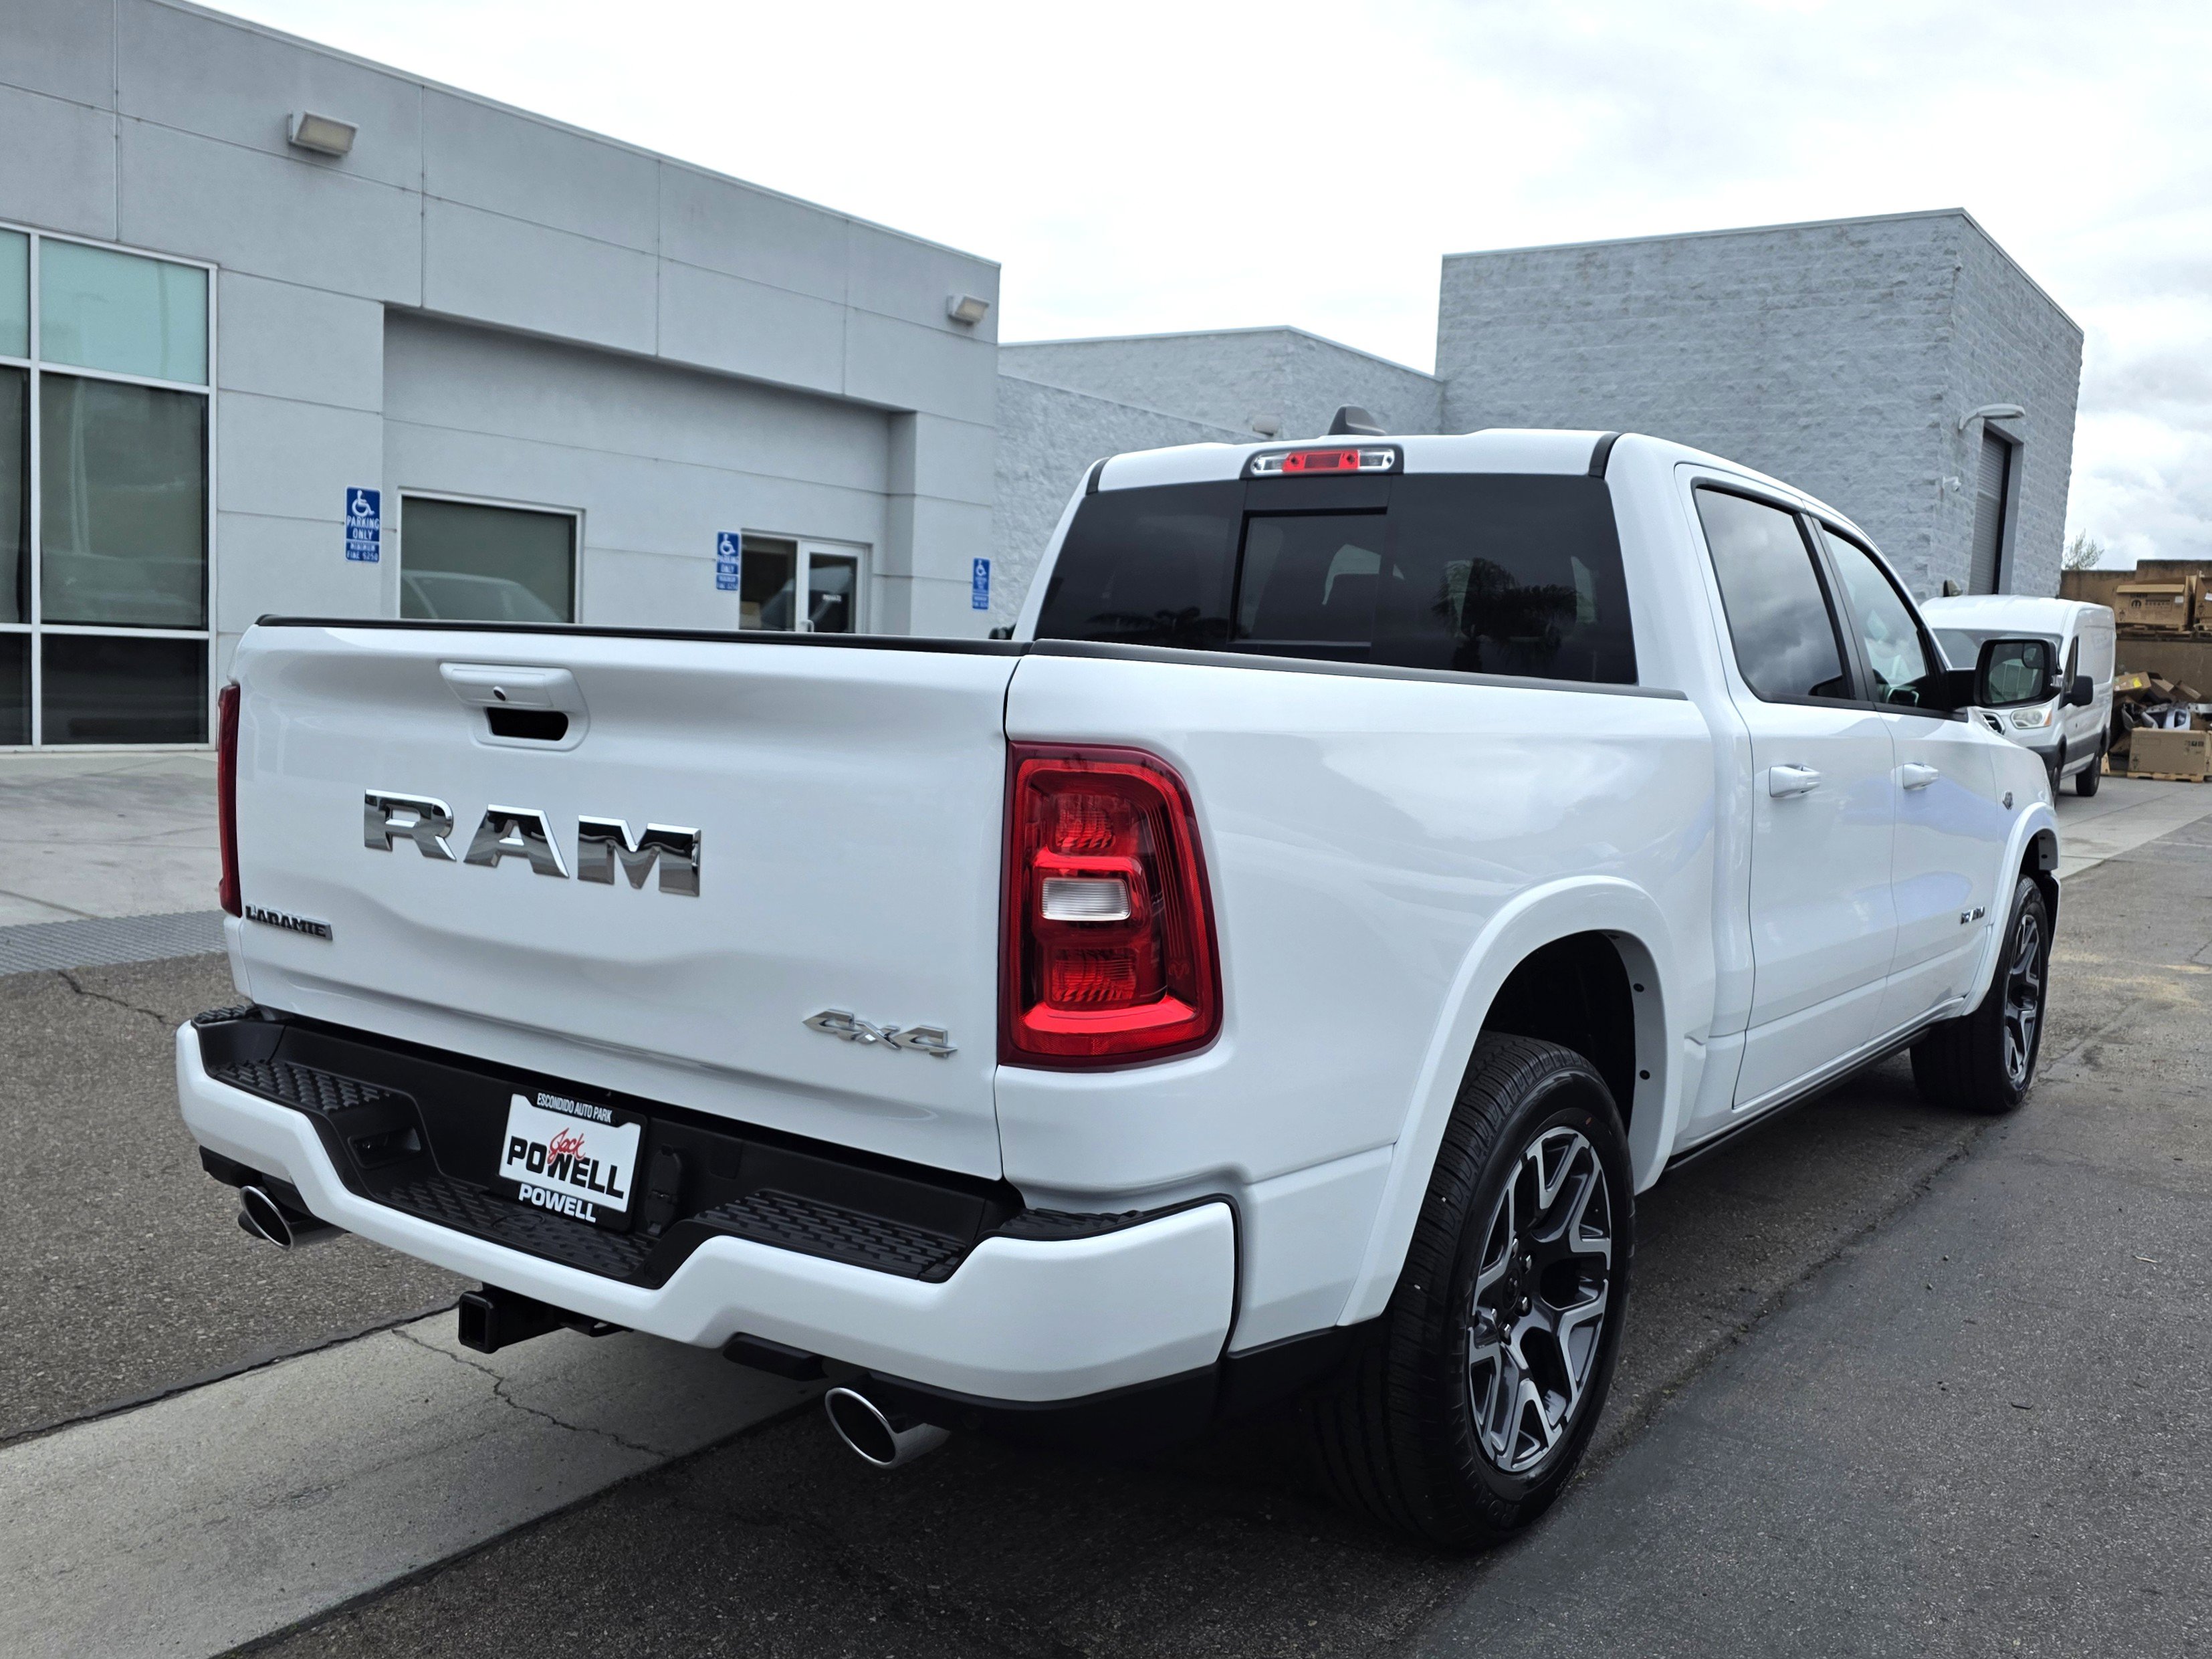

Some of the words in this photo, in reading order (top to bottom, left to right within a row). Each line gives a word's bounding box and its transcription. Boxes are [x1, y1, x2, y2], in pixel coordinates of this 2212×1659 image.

[347, 515, 380, 530] PARKING
[352, 528, 373, 540] ONLY
[364, 789, 700, 897] RAM
[245, 904, 332, 940] LARAMIE
[537, 1093, 575, 1114] ESCONDIDO
[574, 1102, 593, 1119] AUTO
[592, 1107, 613, 1123] PARK
[547, 1127, 586, 1165] Jack
[507, 1135, 624, 1200] POWELL
[518, 1184, 596, 1223] POWELL
